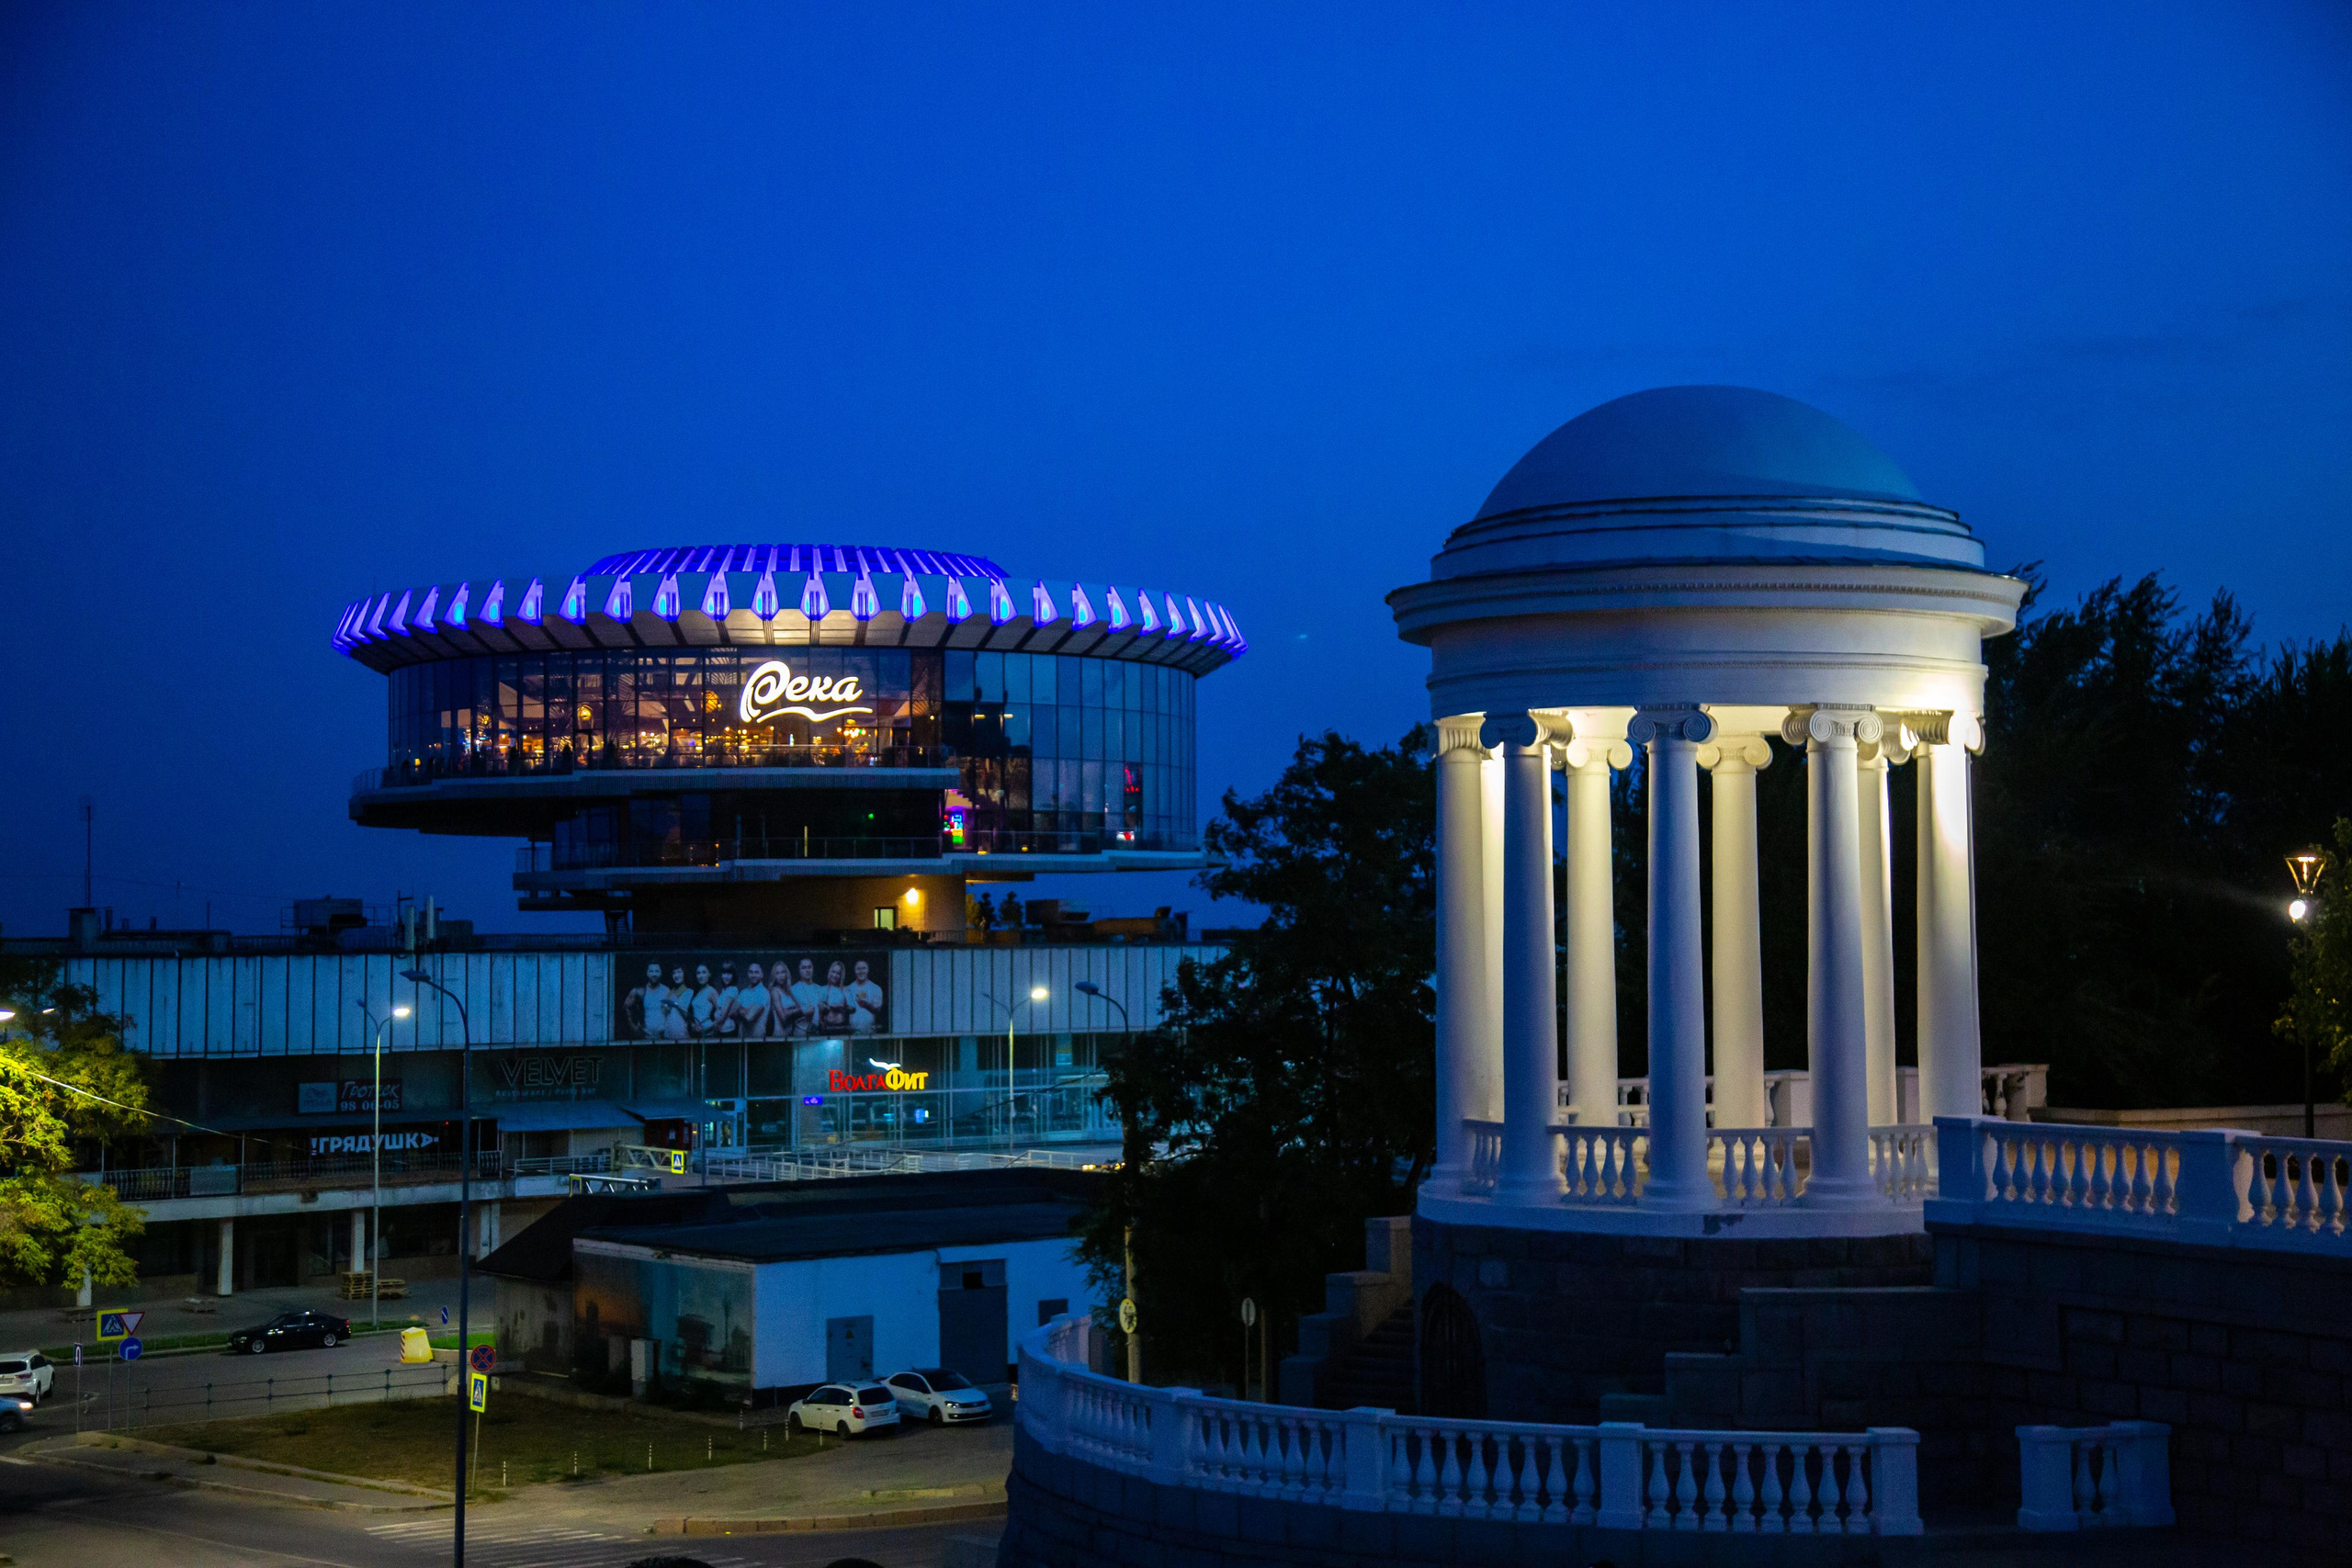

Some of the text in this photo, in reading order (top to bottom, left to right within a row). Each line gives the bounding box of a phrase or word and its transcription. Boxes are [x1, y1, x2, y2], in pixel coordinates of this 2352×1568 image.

[741, 660, 864, 724] Река
[500, 1055, 605, 1087] VELVET
[340, 1100, 356, 1111] 98
